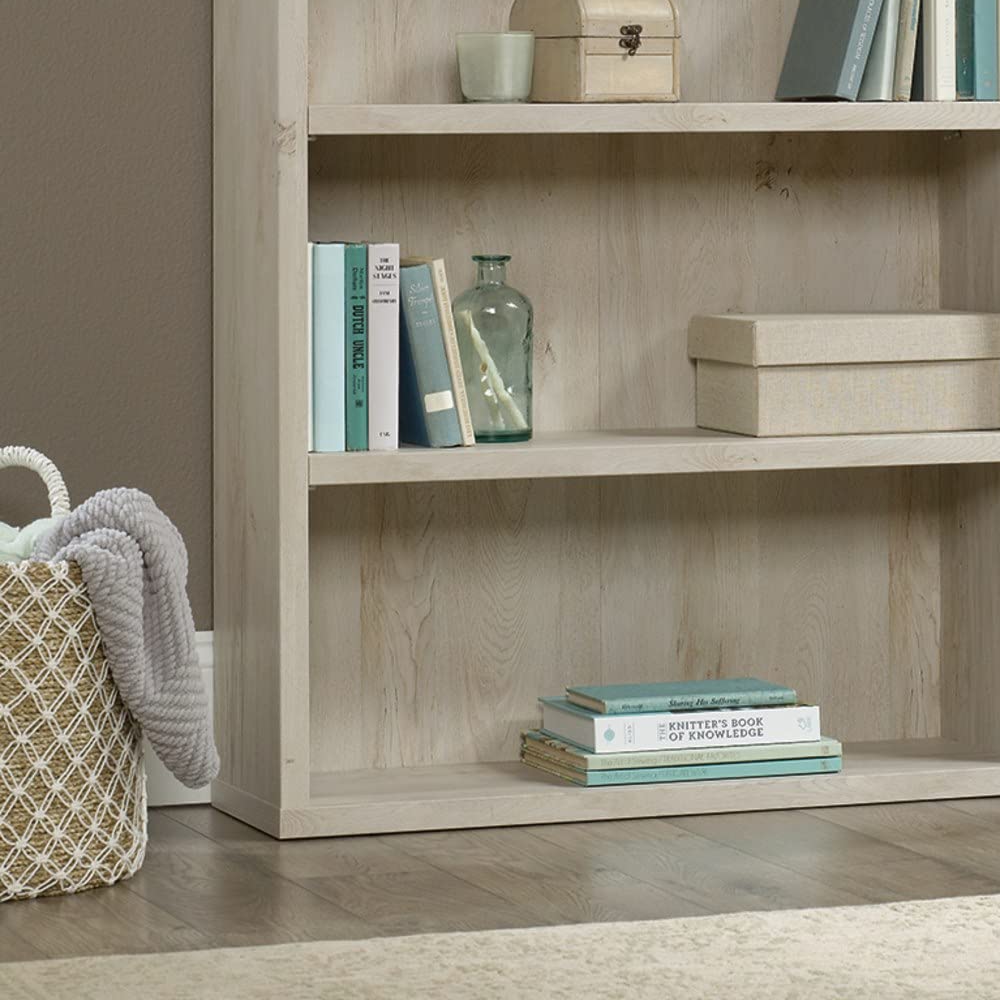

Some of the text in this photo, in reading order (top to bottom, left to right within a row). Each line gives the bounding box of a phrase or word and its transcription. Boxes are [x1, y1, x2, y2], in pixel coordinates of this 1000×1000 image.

[352, 304, 364, 334] DUTCH
[352, 339, 364, 369] UNCLE
[668, 694, 740, 708] Sharing His Suffering
[659, 723, 667, 740] THE
[669, 717, 764, 731] KNITTER'S BOOK
[669, 728, 764, 742] OF KNOWLEDGE
